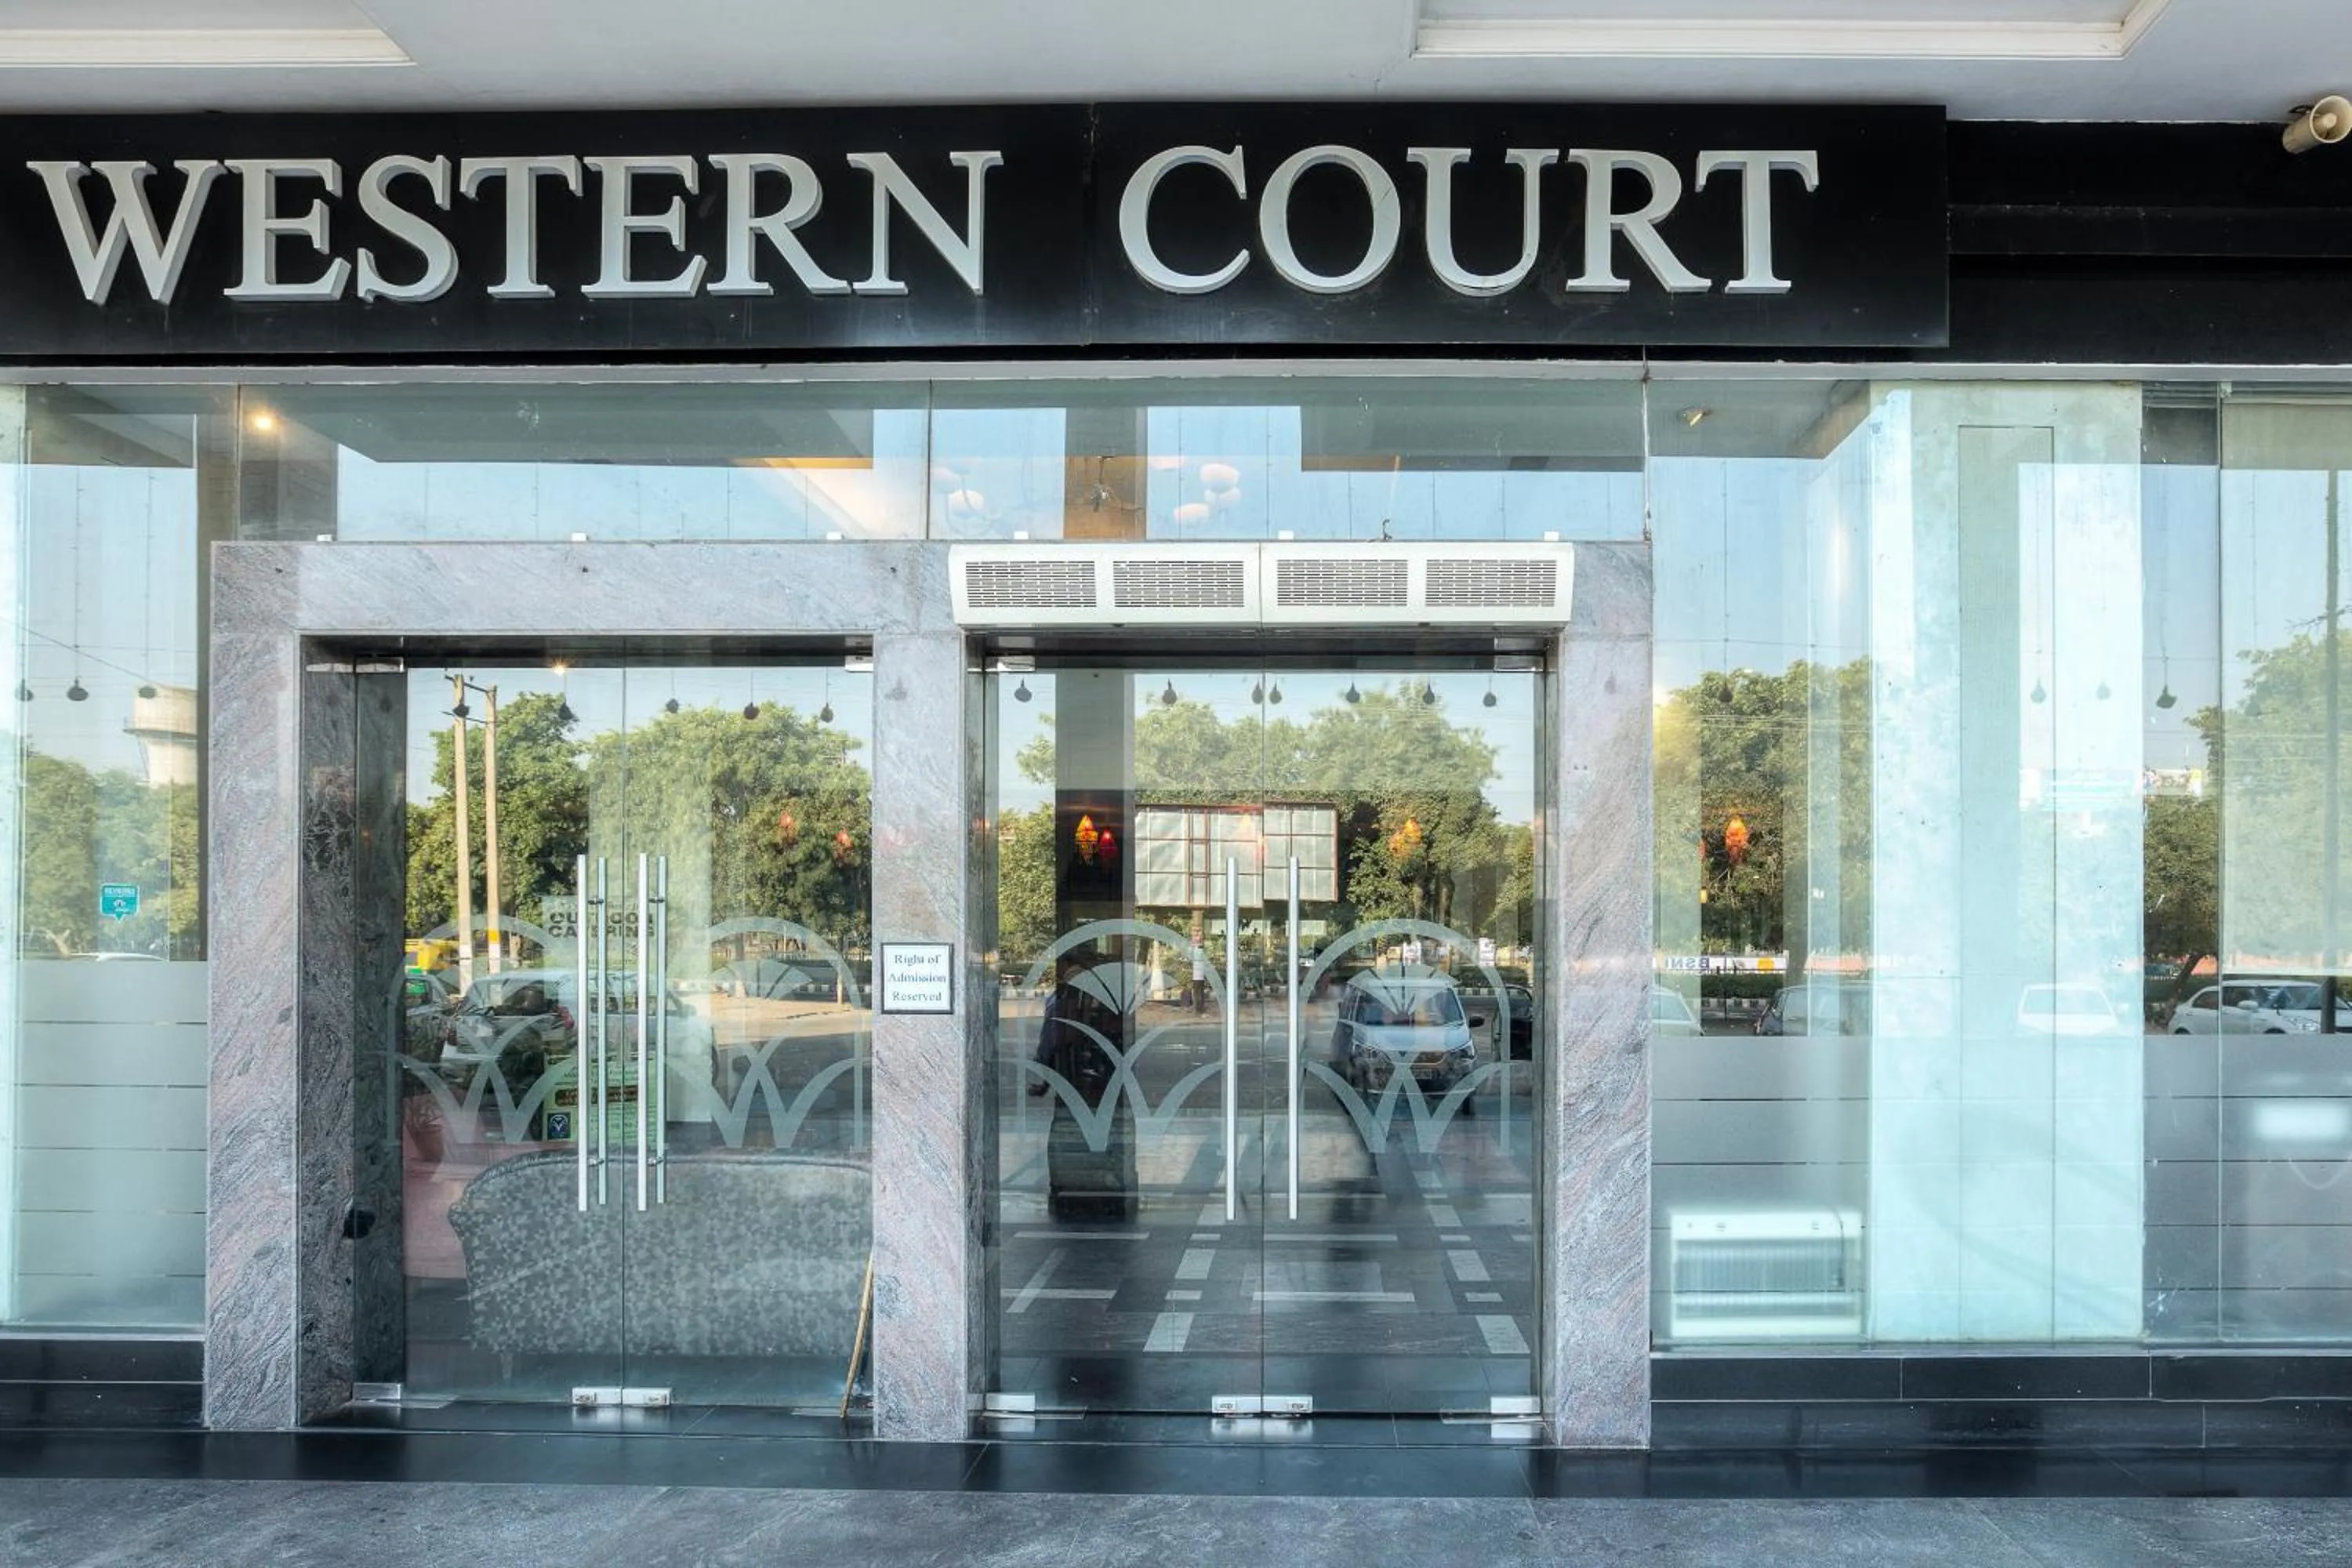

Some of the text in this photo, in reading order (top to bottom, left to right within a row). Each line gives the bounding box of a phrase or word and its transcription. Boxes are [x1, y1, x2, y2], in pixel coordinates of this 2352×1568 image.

[27, 144, 1820, 306] WESTERN COURT
[550, 912, 654, 924] OUOO
[548, 925, 655, 938] CAERING
[895, 953, 942, 966] Right of
[887, 972, 947, 982] Admission
[892, 991, 942, 1001] Reserved
